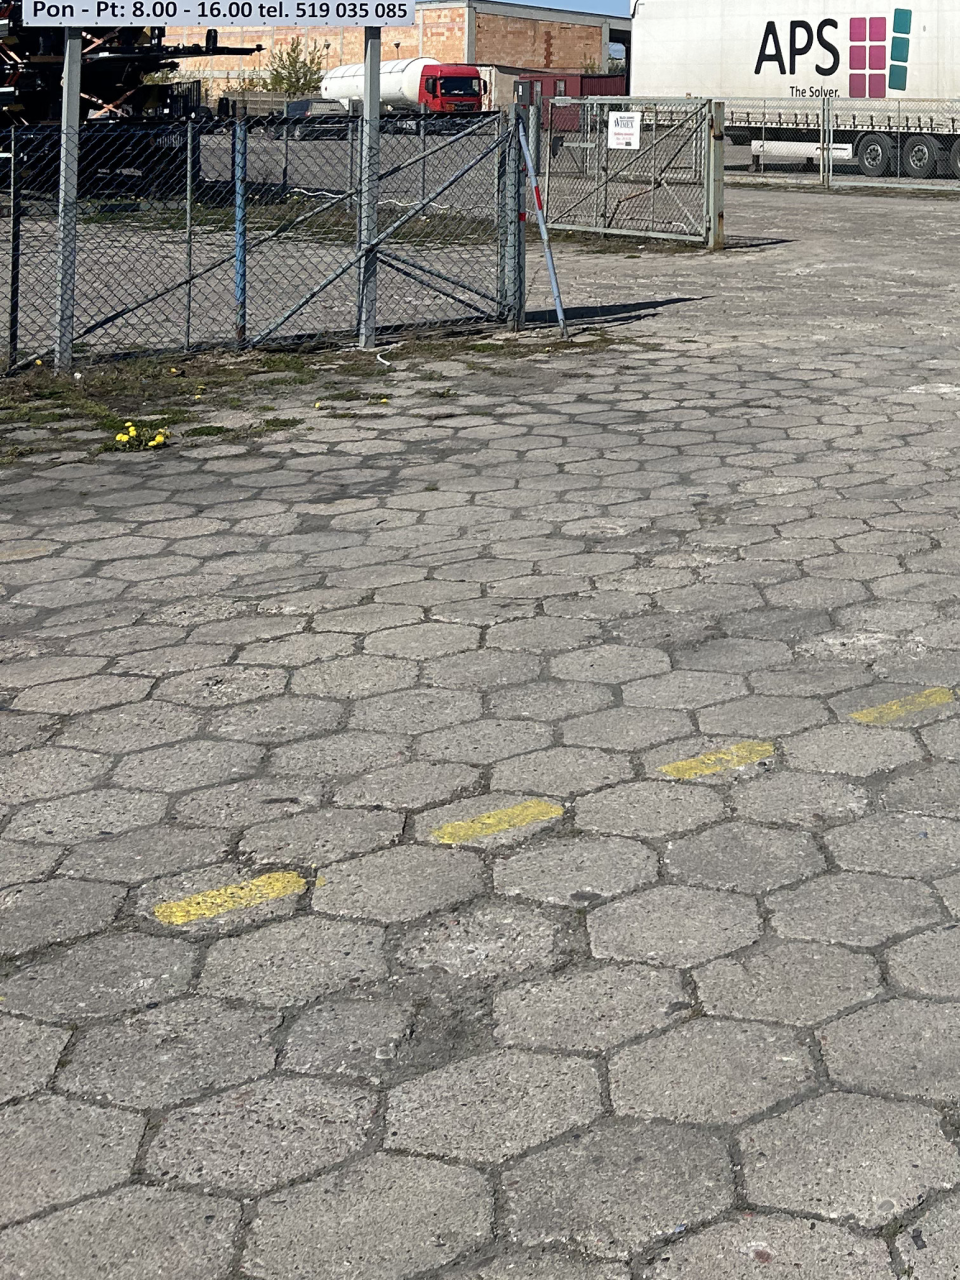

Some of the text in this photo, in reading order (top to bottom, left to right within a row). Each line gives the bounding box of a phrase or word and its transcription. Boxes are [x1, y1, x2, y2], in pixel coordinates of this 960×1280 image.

[33, 0, 74, 18] Pon
[96, 0, 125, 18] Pt:
[132, 0, 178, 18] 8.00
[197, 1, 253, 18] 16.00
[258, 1, 289, 18] tel.
[295, 2, 330, 18] 519
[335, 2, 369, 19] 035
[374, 2, 408, 19] 085
[753, 17, 840, 77] APS
[789, 85, 840, 99] The Solver.
